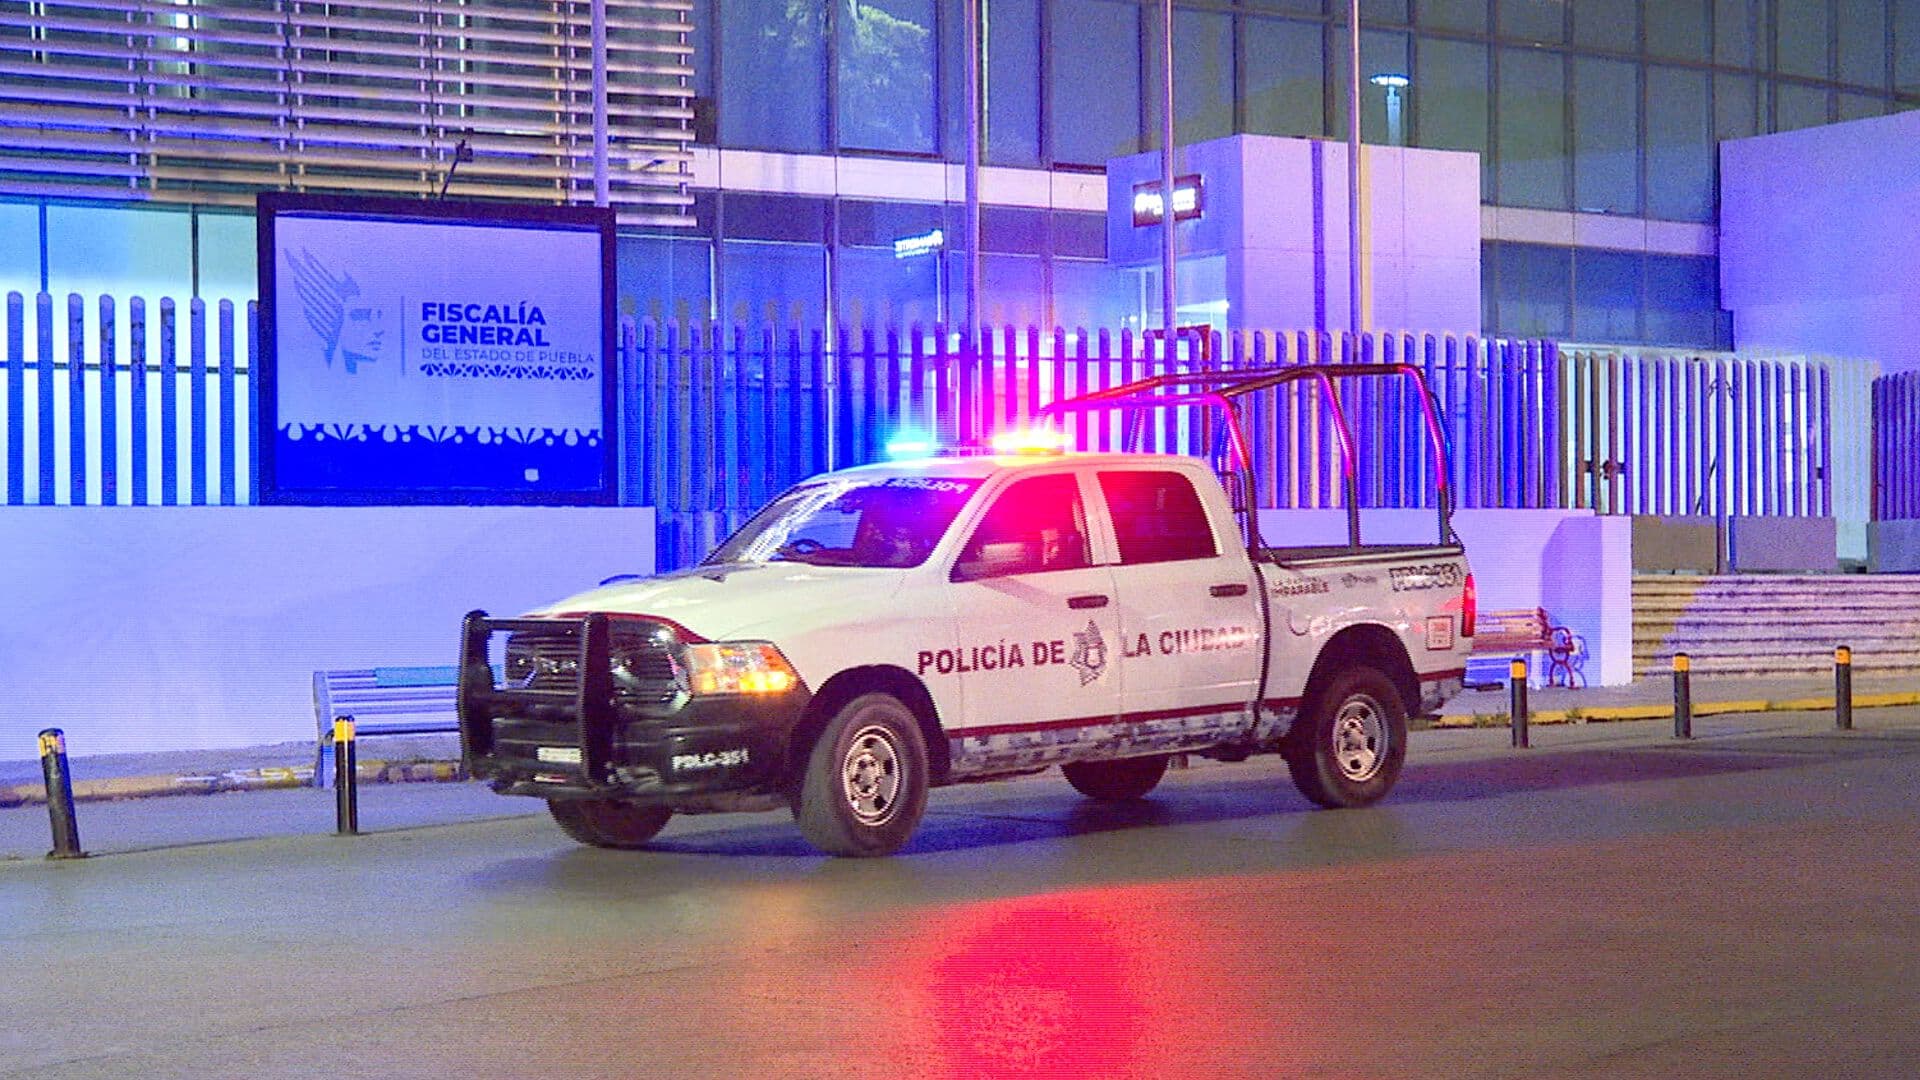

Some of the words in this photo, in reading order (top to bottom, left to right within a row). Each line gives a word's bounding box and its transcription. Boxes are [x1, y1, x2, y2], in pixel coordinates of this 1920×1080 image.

[422, 301, 547, 326] FISCALÍA
[421, 324, 551, 347] GENERAL
[421, 348, 450, 360] DEL
[454, 349, 511, 361] ESTADO
[515, 350, 535, 362] DE
[538, 351, 595, 364] PUEBLA
[917, 638, 1025, 675] POLICÍA
[1031, 640, 1065, 666] DE
[1121, 632, 1151, 658] LA
[1158, 626, 1246, 655] CIUDAD
